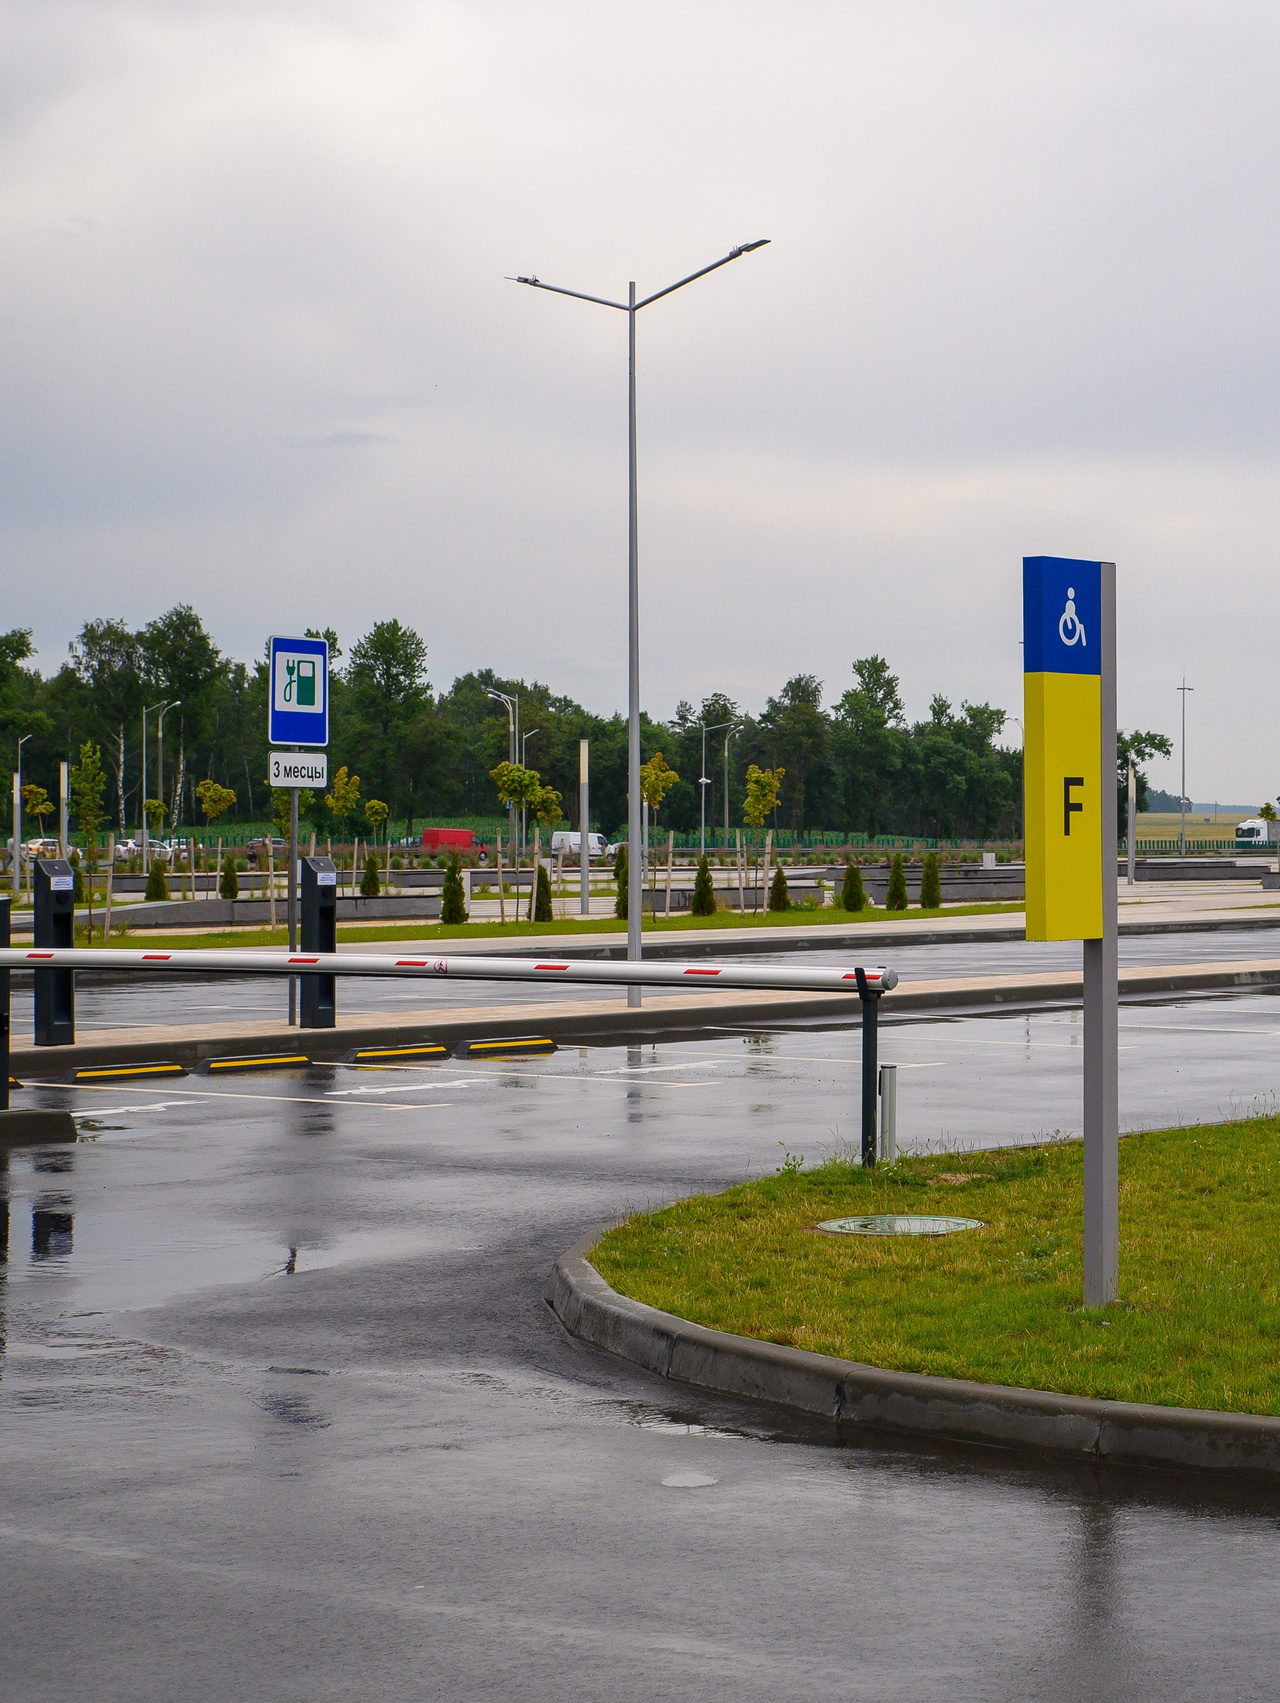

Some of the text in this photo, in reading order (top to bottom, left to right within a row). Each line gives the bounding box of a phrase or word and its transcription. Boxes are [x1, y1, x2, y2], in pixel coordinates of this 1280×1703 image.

[273, 761, 325, 782] 3 месцы
[1063, 776, 1085, 837] F
